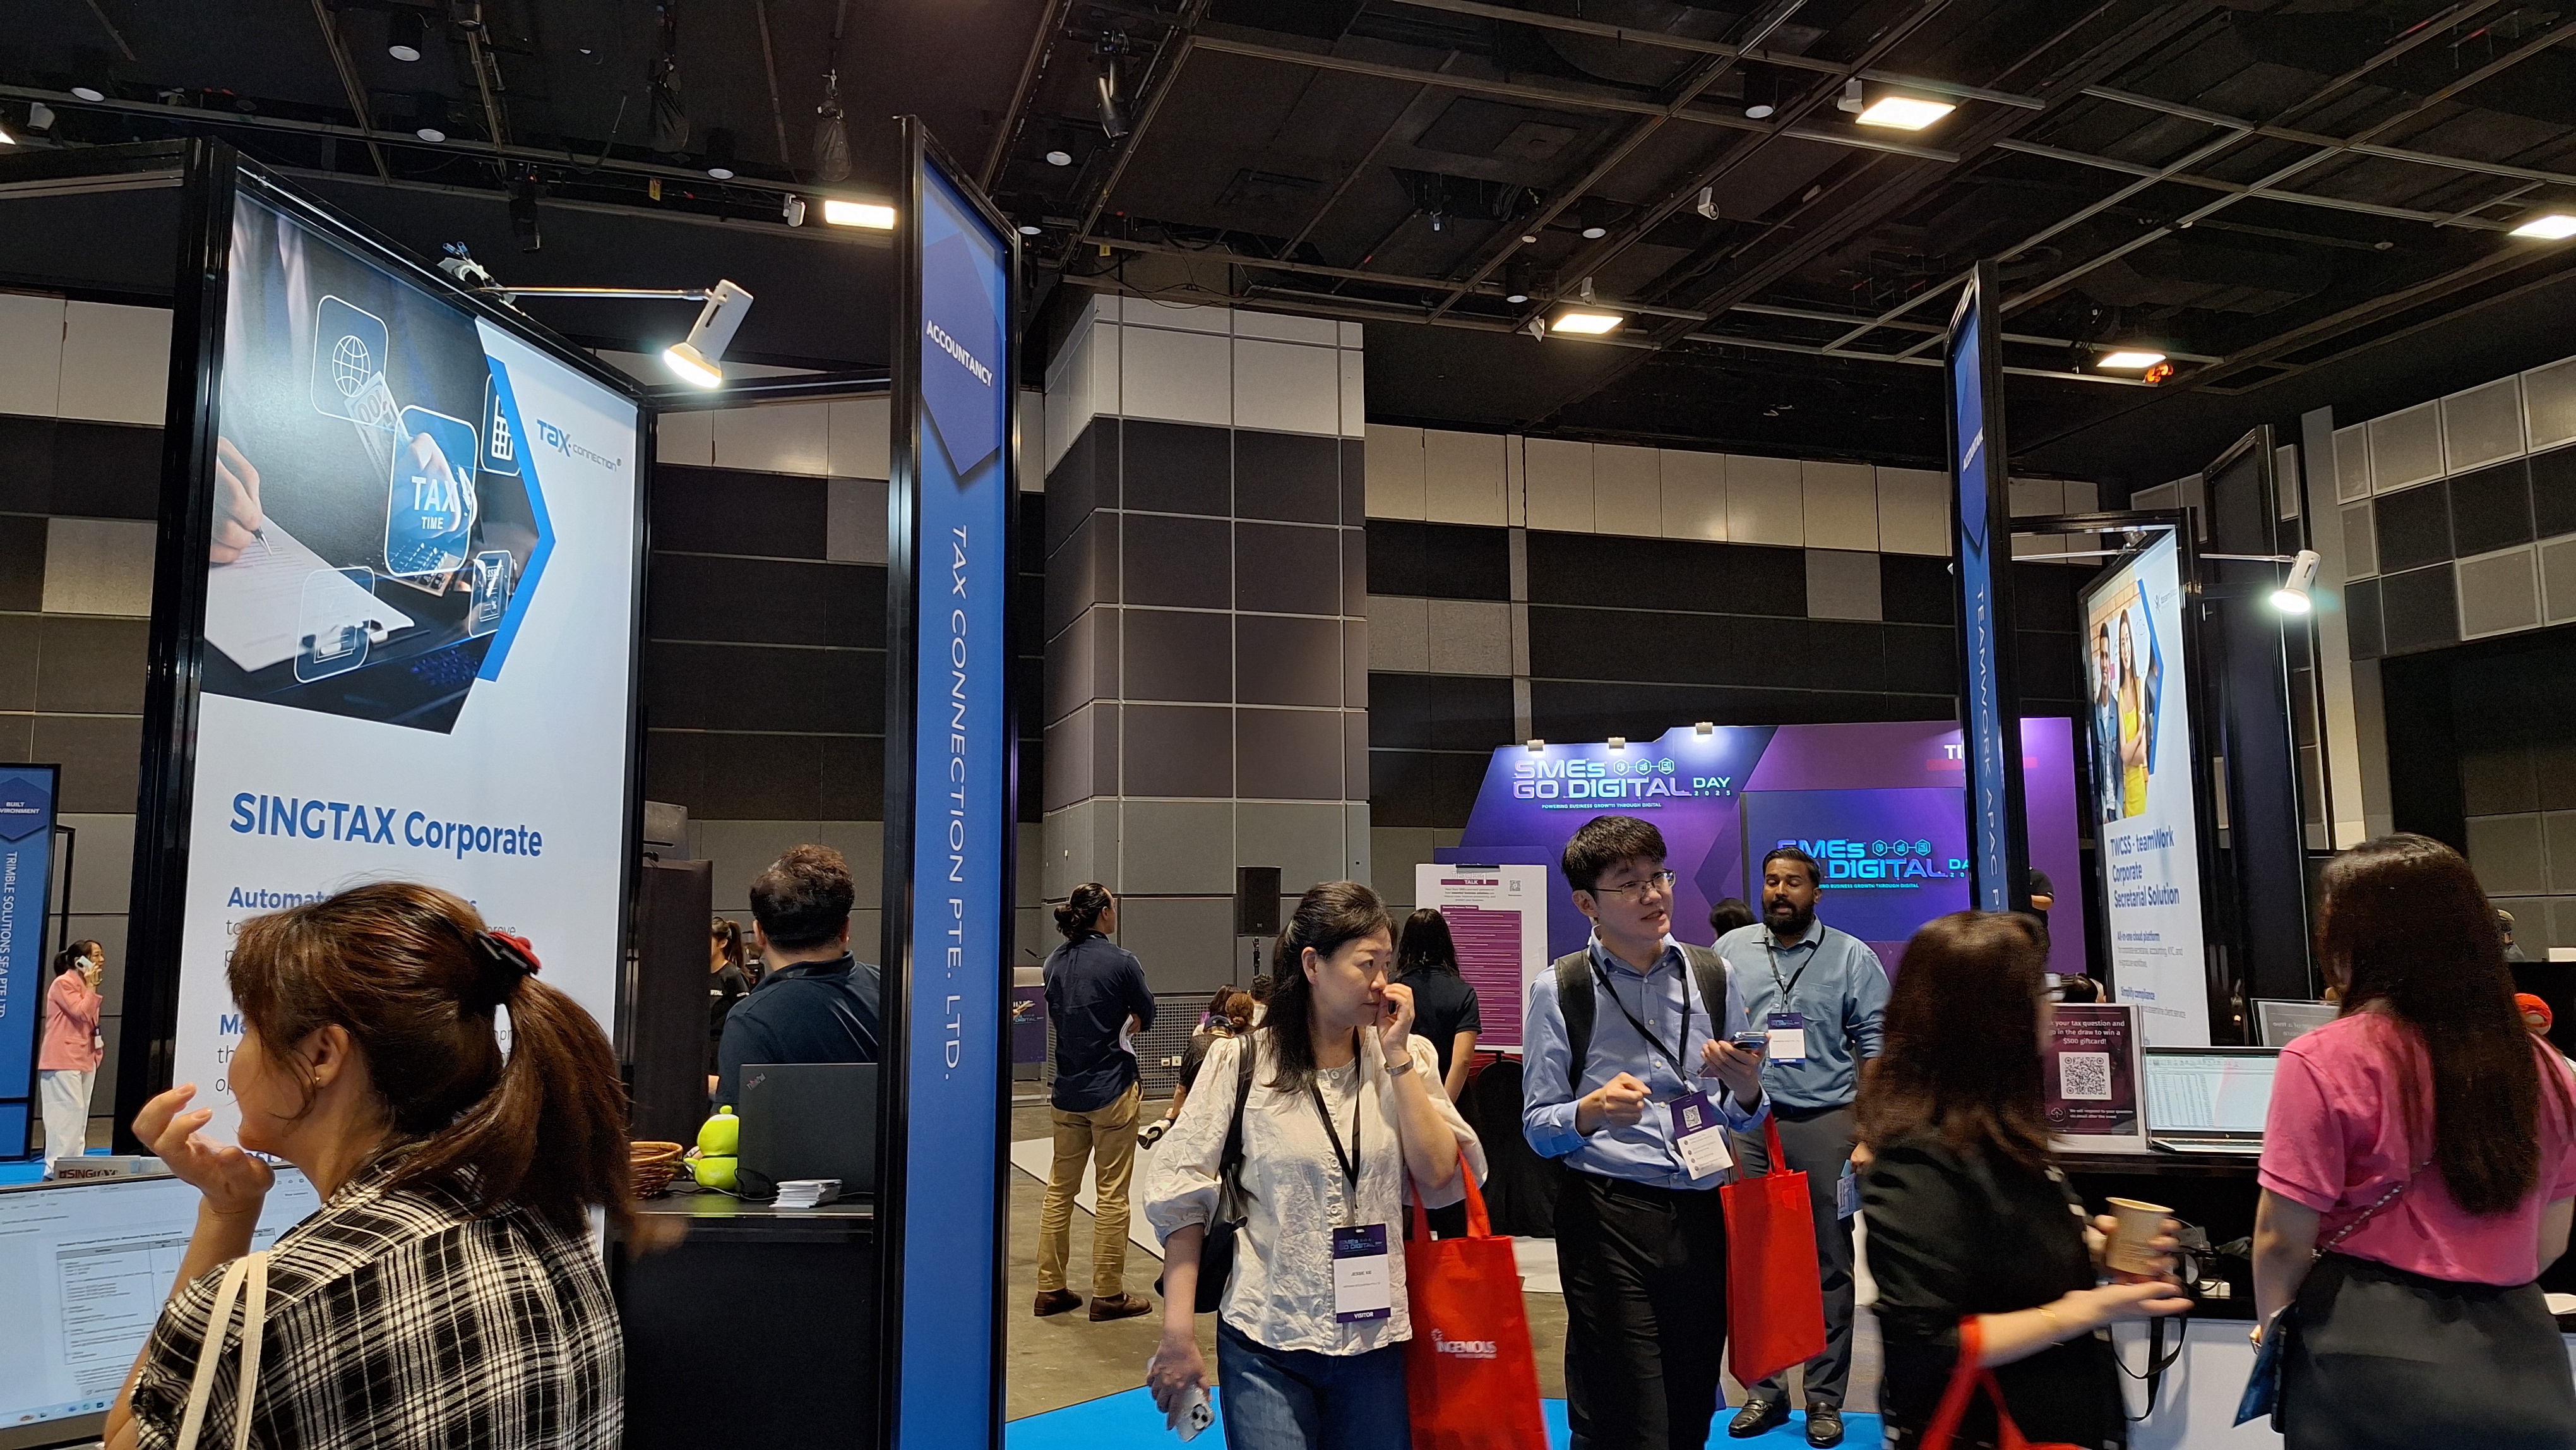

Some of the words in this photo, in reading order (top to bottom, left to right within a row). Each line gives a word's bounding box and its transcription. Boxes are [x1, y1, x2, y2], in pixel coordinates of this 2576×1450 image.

[926, 320, 993, 387] ACCOUNTANCY
[412, 476, 457, 512] TAX
[421, 516, 444, 530] TIME
[952, 524, 967, 600] TAX
[949, 609, 967, 882] CONNECTION
[1977, 583, 1992, 778] TEAMWORK
[1986, 788, 1998, 877] APAC
[1513, 780, 1559, 800] GO
[1565, 777, 1692, 800] DIGITAL
[1693, 777, 1731, 788] DAY
[1514, 759, 1606, 779] SMEs
[230, 793, 397, 845] SINGTAX
[405, 811, 543, 860] Corporate
[2110, 834, 2132, 857] TWCSS
[2136, 825, 2175, 853] teamWork
[4, 851, 18, 894] TRIMBLE
[1826, 858, 1948, 879] DIGITAL
[1948, 859, 1969, 869] DA
[2112, 861, 2143, 886] Corporate
[2114, 885, 2147, 909] Secretarial
[2148, 882, 2180, 906] Solution
[0, 895, 15, 954] SOLUTIONS
[947, 899, 963, 979] PTE.
[945, 995, 961, 1081] LTD.
[2080, 1038, 2107, 1046] giftcard!
